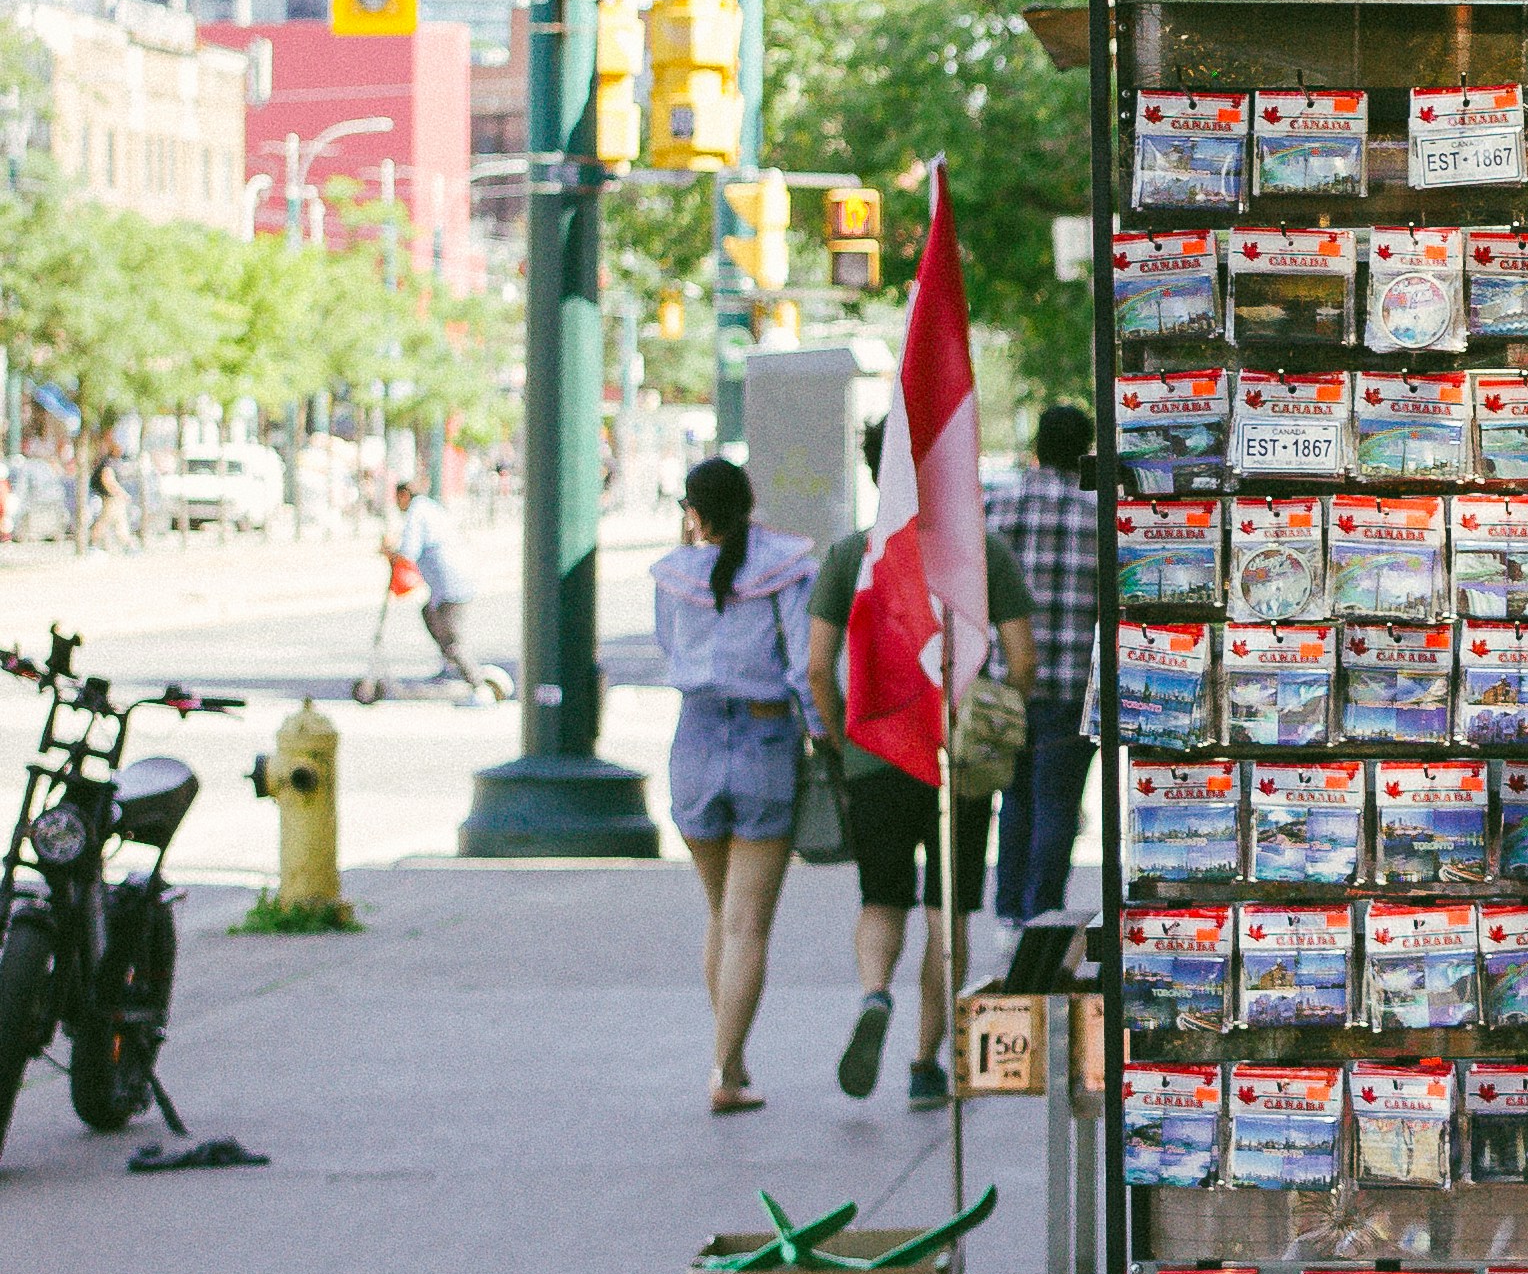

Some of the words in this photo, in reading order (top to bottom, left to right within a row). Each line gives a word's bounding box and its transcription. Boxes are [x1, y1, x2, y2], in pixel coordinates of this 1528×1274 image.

[1171, 119, 1232, 132] CANADA
[1290, 120, 1351, 131] CANADA
[1474, 146, 1513, 168] 1867
[1140, 258, 1201, 273] CANADA
[1269, 255, 1329, 268] CANADA
[1150, 402, 1211, 414] CANADA
[1271, 403, 1333, 415] CANADA
[1391, 403, 1452, 415] CANADA
[1272, 428, 1307, 436] CANADA
[1293, 439, 1332, 458] 1867
[1144, 528, 1206, 539] CANADA
[1364, 528, 1424, 542] CANADA
[1377, 651, 1437, 663] CANADA
[1412, 792, 1473, 802] CANADA
[1155, 940, 1215, 952] CANADA
[1264, 1099, 1325, 1111] CANADA
